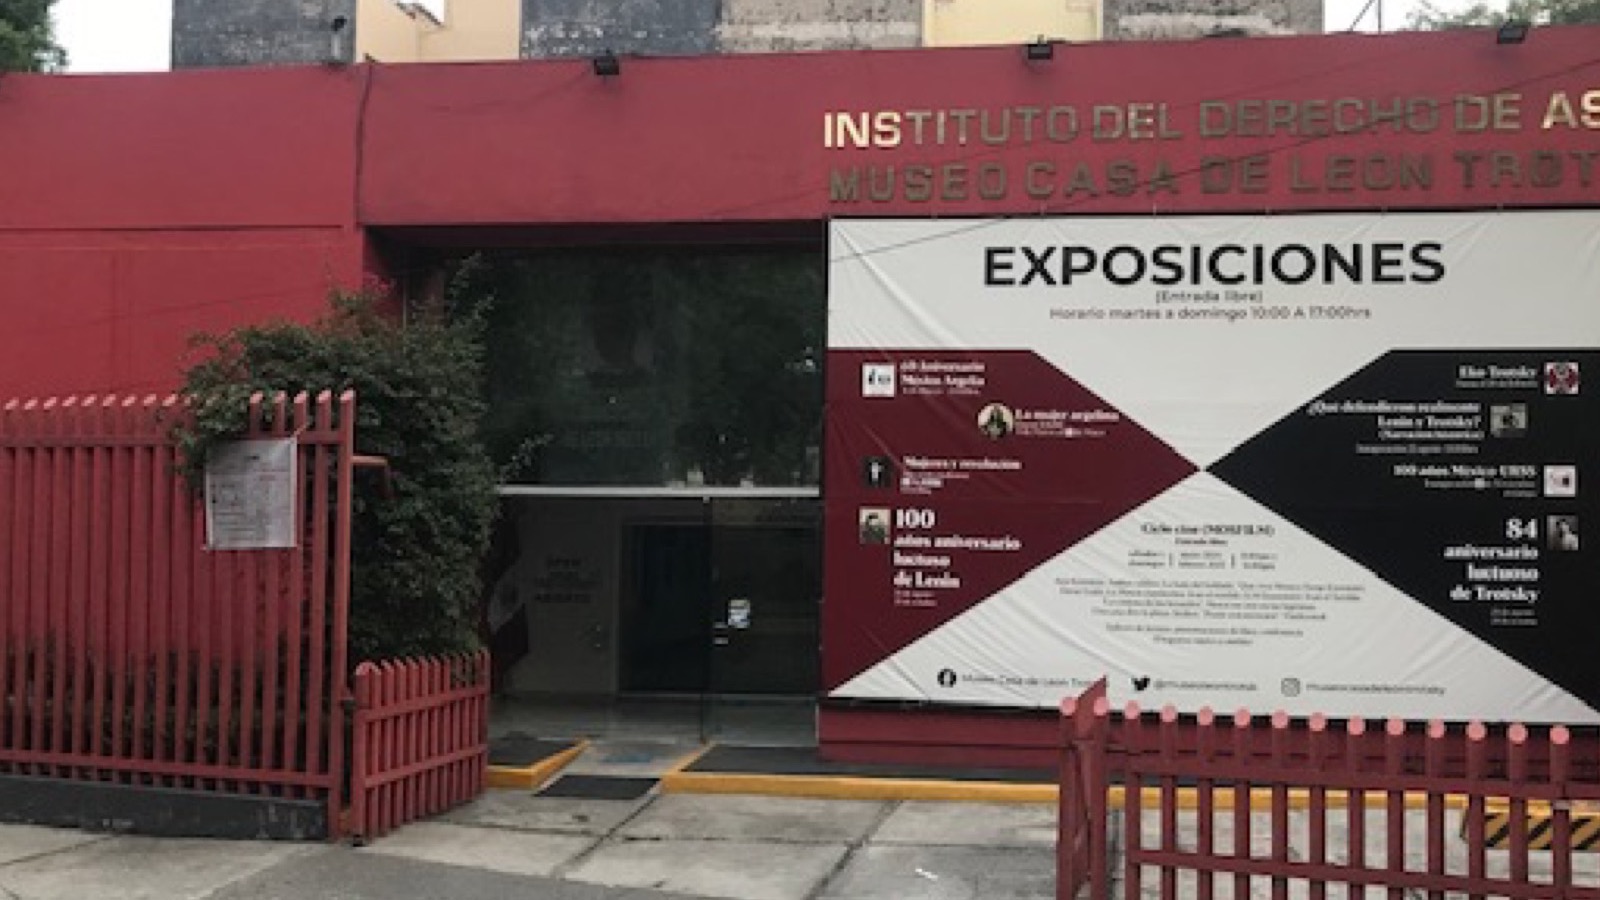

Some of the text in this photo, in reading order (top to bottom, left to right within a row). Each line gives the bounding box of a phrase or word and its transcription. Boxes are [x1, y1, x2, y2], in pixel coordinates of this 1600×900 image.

[824, 104, 1079, 148] INSTITUTO
[1091, 102, 1183, 140] DEL
[1199, 97, 1441, 137] DERECHO
[1454, 93, 1521, 132] DE
[829, 150, 1600, 202] MUSEO CASA DE LEON TROT
[984, 241, 1446, 287] EXPOSICIONES
[1156, 290, 1263, 304] (Entrada libre)
[1050, 305, 1371, 323] Horario martes a domingo 10:00 A 17:00hrs
[896, 508, 936, 530] 100
[1505, 518, 1538, 539] 84
[893, 534, 1022, 550] años aniversario
[893, 550, 951, 568] luctuoso
[1443, 544, 1539, 560] aniversario
[893, 570, 961, 588] de Lenin
[1468, 563, 1539, 581] luctuoso
[1450, 584, 1539, 604] de Trotsky
